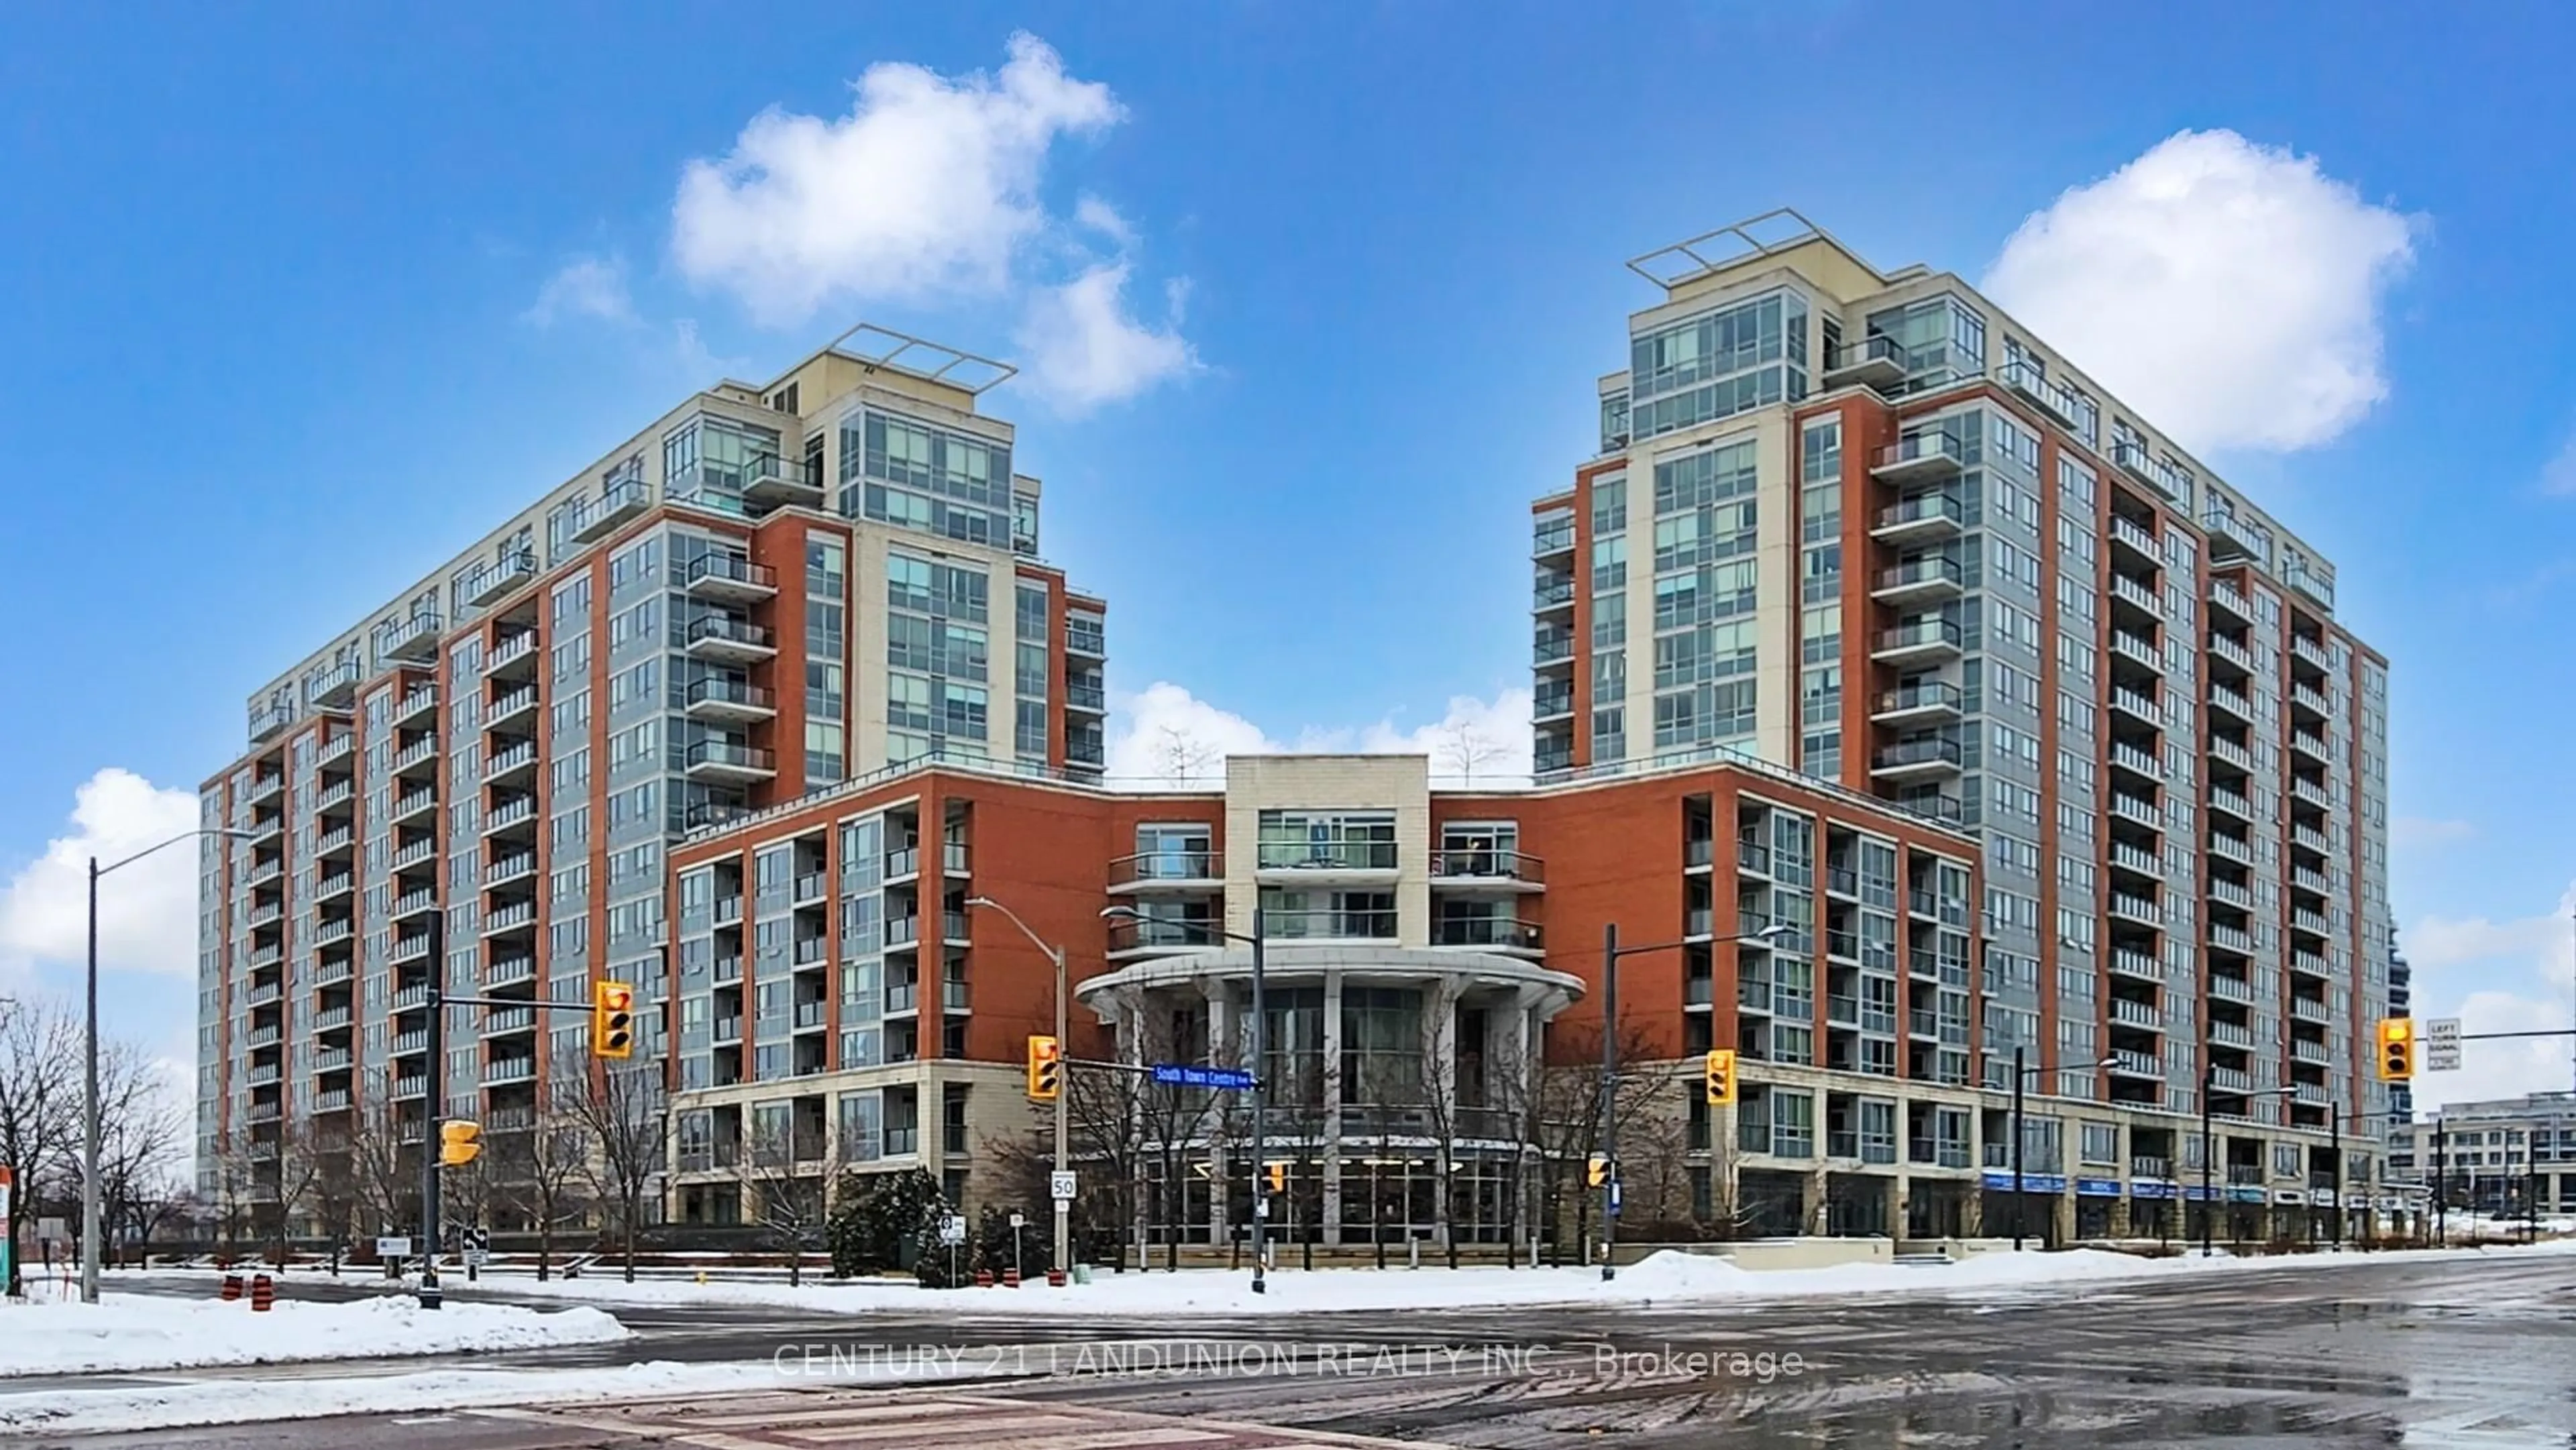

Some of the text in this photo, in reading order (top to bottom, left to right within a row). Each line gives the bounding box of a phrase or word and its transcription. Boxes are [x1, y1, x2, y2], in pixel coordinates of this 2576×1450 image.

[2432, 1025, 2455, 1033] LEFT
[1157, 1067, 1181, 1081] South
[1184, 1068, 1205, 1082] Town
[1209, 1072, 1236, 1085] Centre
[1054, 1180, 1073, 1194] 50
